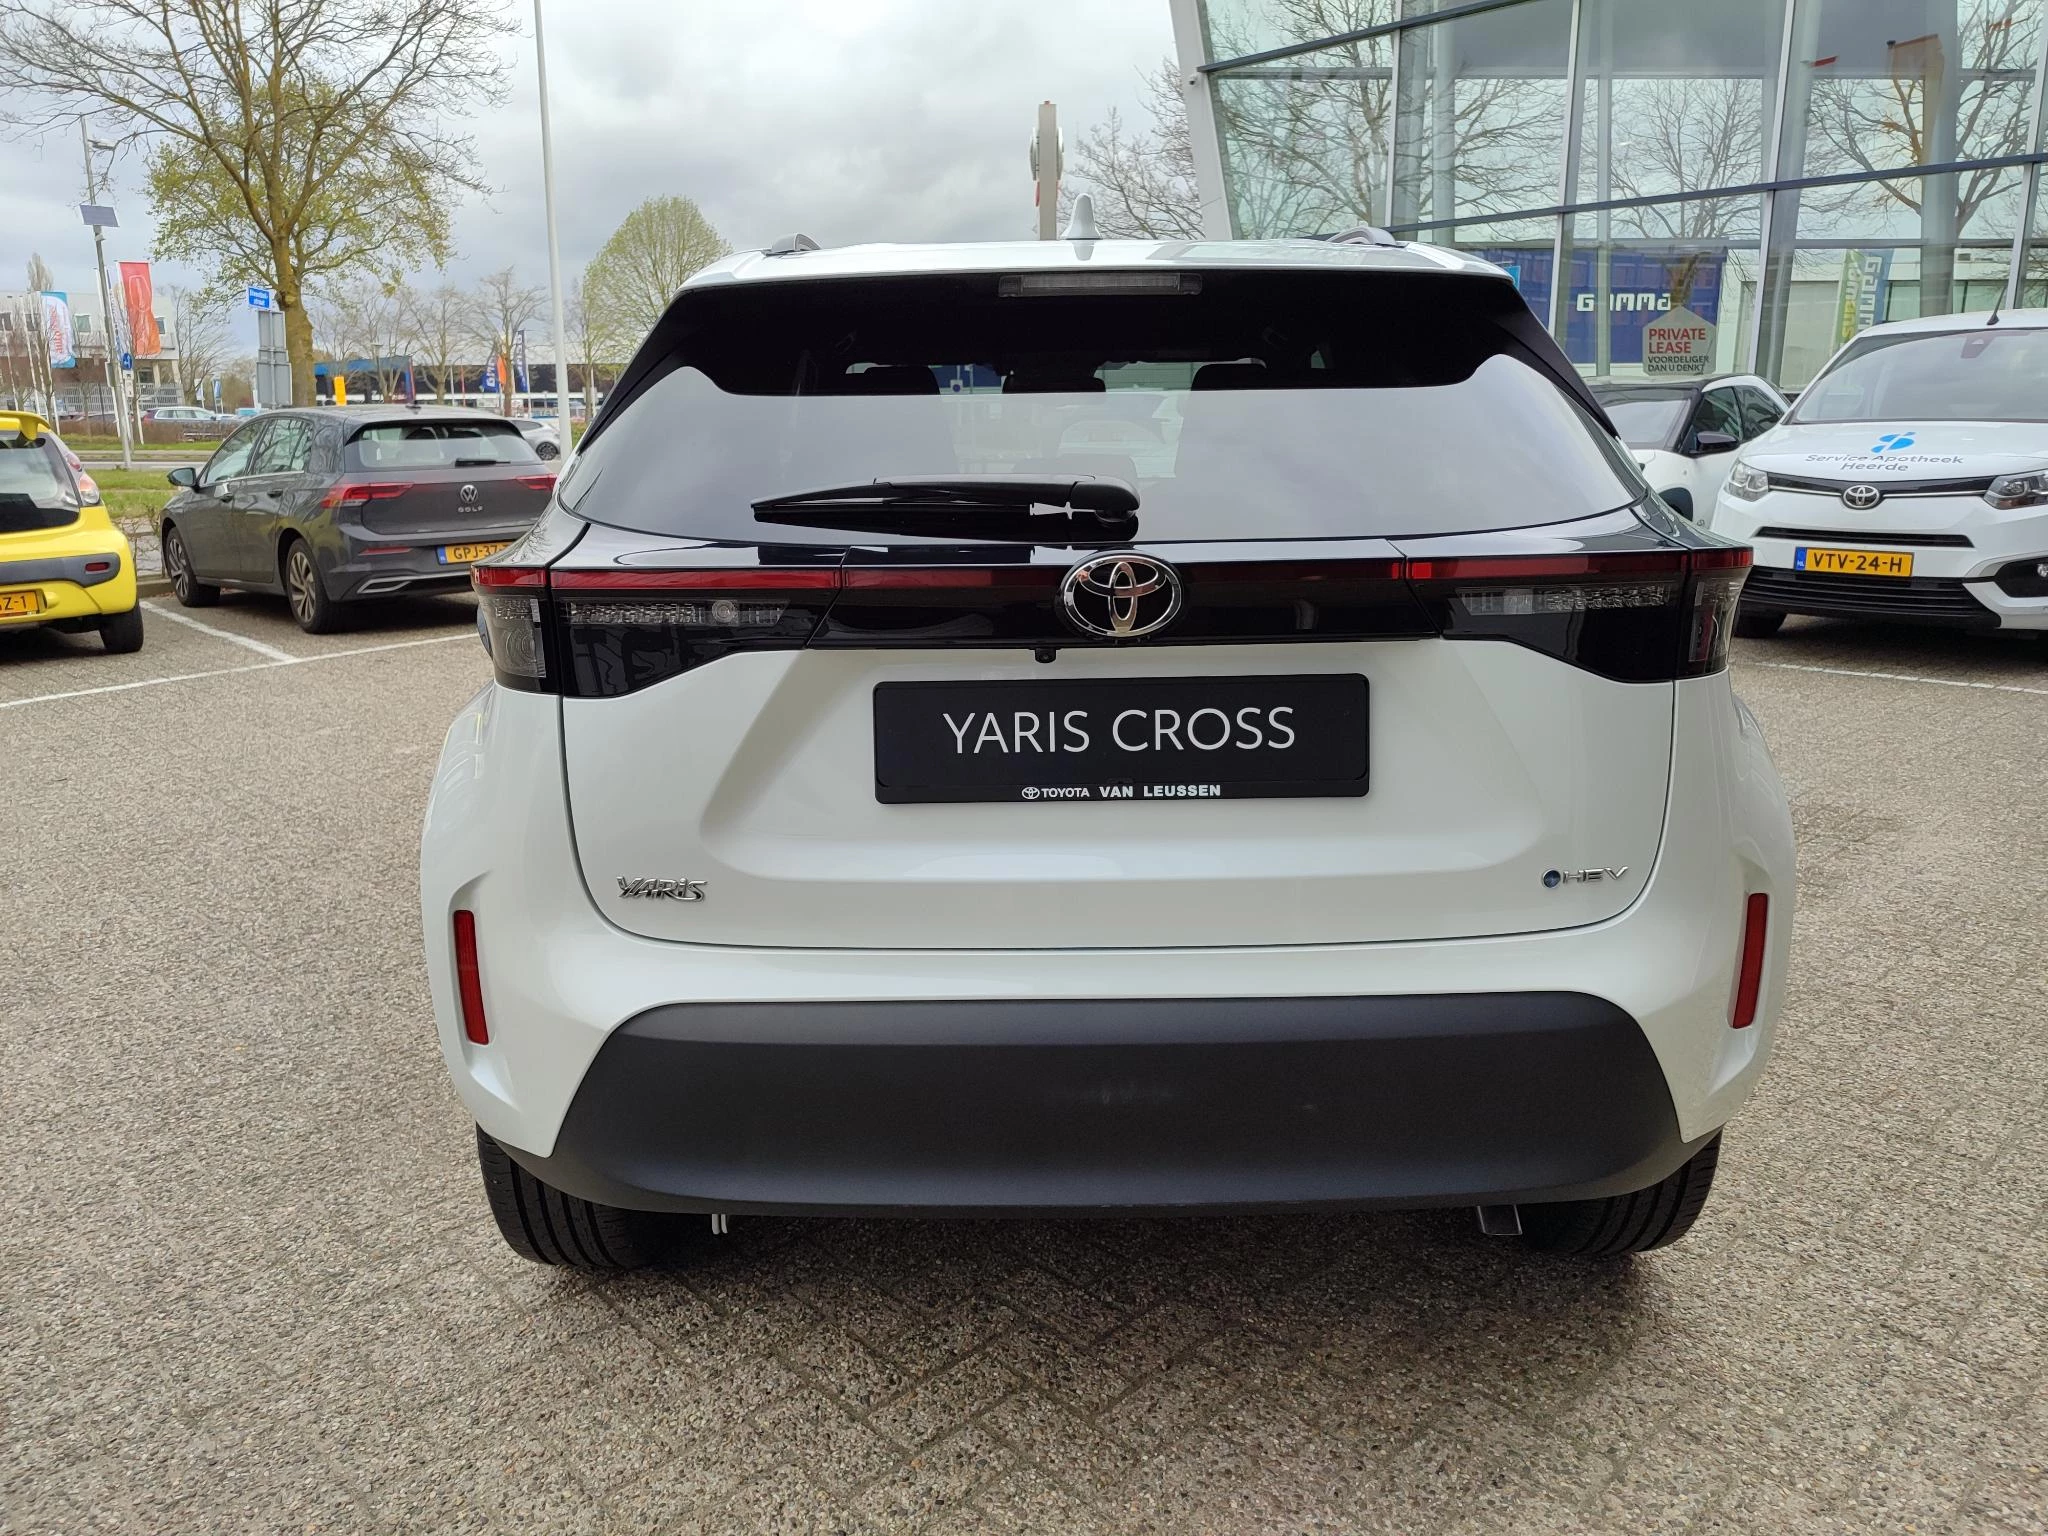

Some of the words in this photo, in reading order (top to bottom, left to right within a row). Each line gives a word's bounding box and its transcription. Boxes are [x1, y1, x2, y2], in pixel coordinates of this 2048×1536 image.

[1648, 328, 1706, 340] PRIVATE
[1648, 342, 1692, 354] LEASE
[1647, 355, 1710, 364] VOORDELIGER
[1648, 364, 1667, 372] DAN
[1668, 364, 1675, 372] U
[1676, 364, 1705, 372] DENKT
[1805, 454, 1868, 462] Service
[1871, 455, 1964, 464] Apotheek
[1840, 462, 1909, 471] Heerde
[453, 545, 508, 560] GPJ-37-
[1813, 552, 1903, 573] VTV-24-H
[943, 711, 1090, 754] YARIS
[1111, 707, 1295, 751] CROSS
[1041, 787, 1090, 798] TOYOTA
[1099, 786, 1134, 797] VAN
[1143, 785, 1221, 796] LEUSSEN
